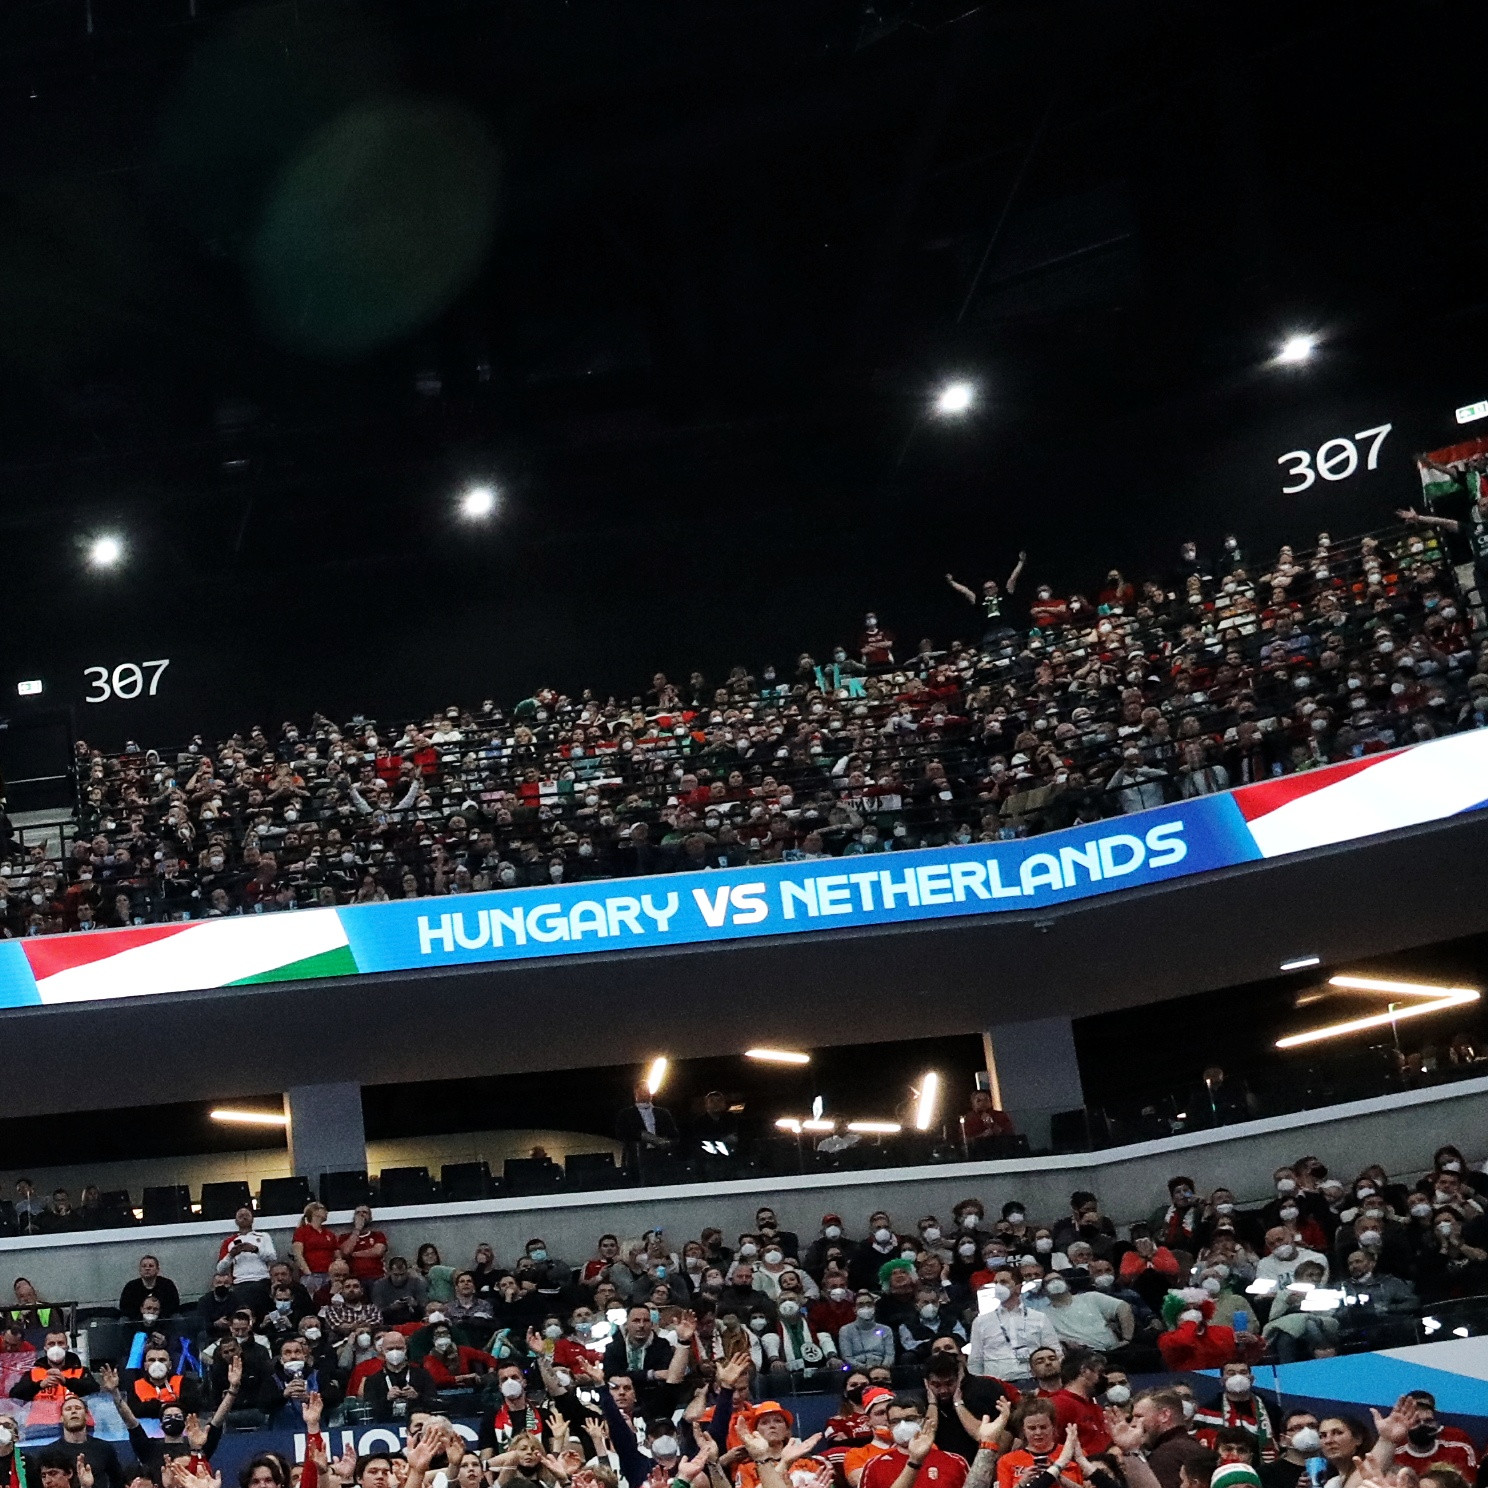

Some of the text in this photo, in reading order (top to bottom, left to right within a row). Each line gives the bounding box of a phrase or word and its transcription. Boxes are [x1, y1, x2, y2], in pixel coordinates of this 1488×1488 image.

[1277, 423, 1392, 494] 307
[84, 659, 170, 703] 307
[418, 820, 1187, 954] HUNGARY VS NETHERLANDS
